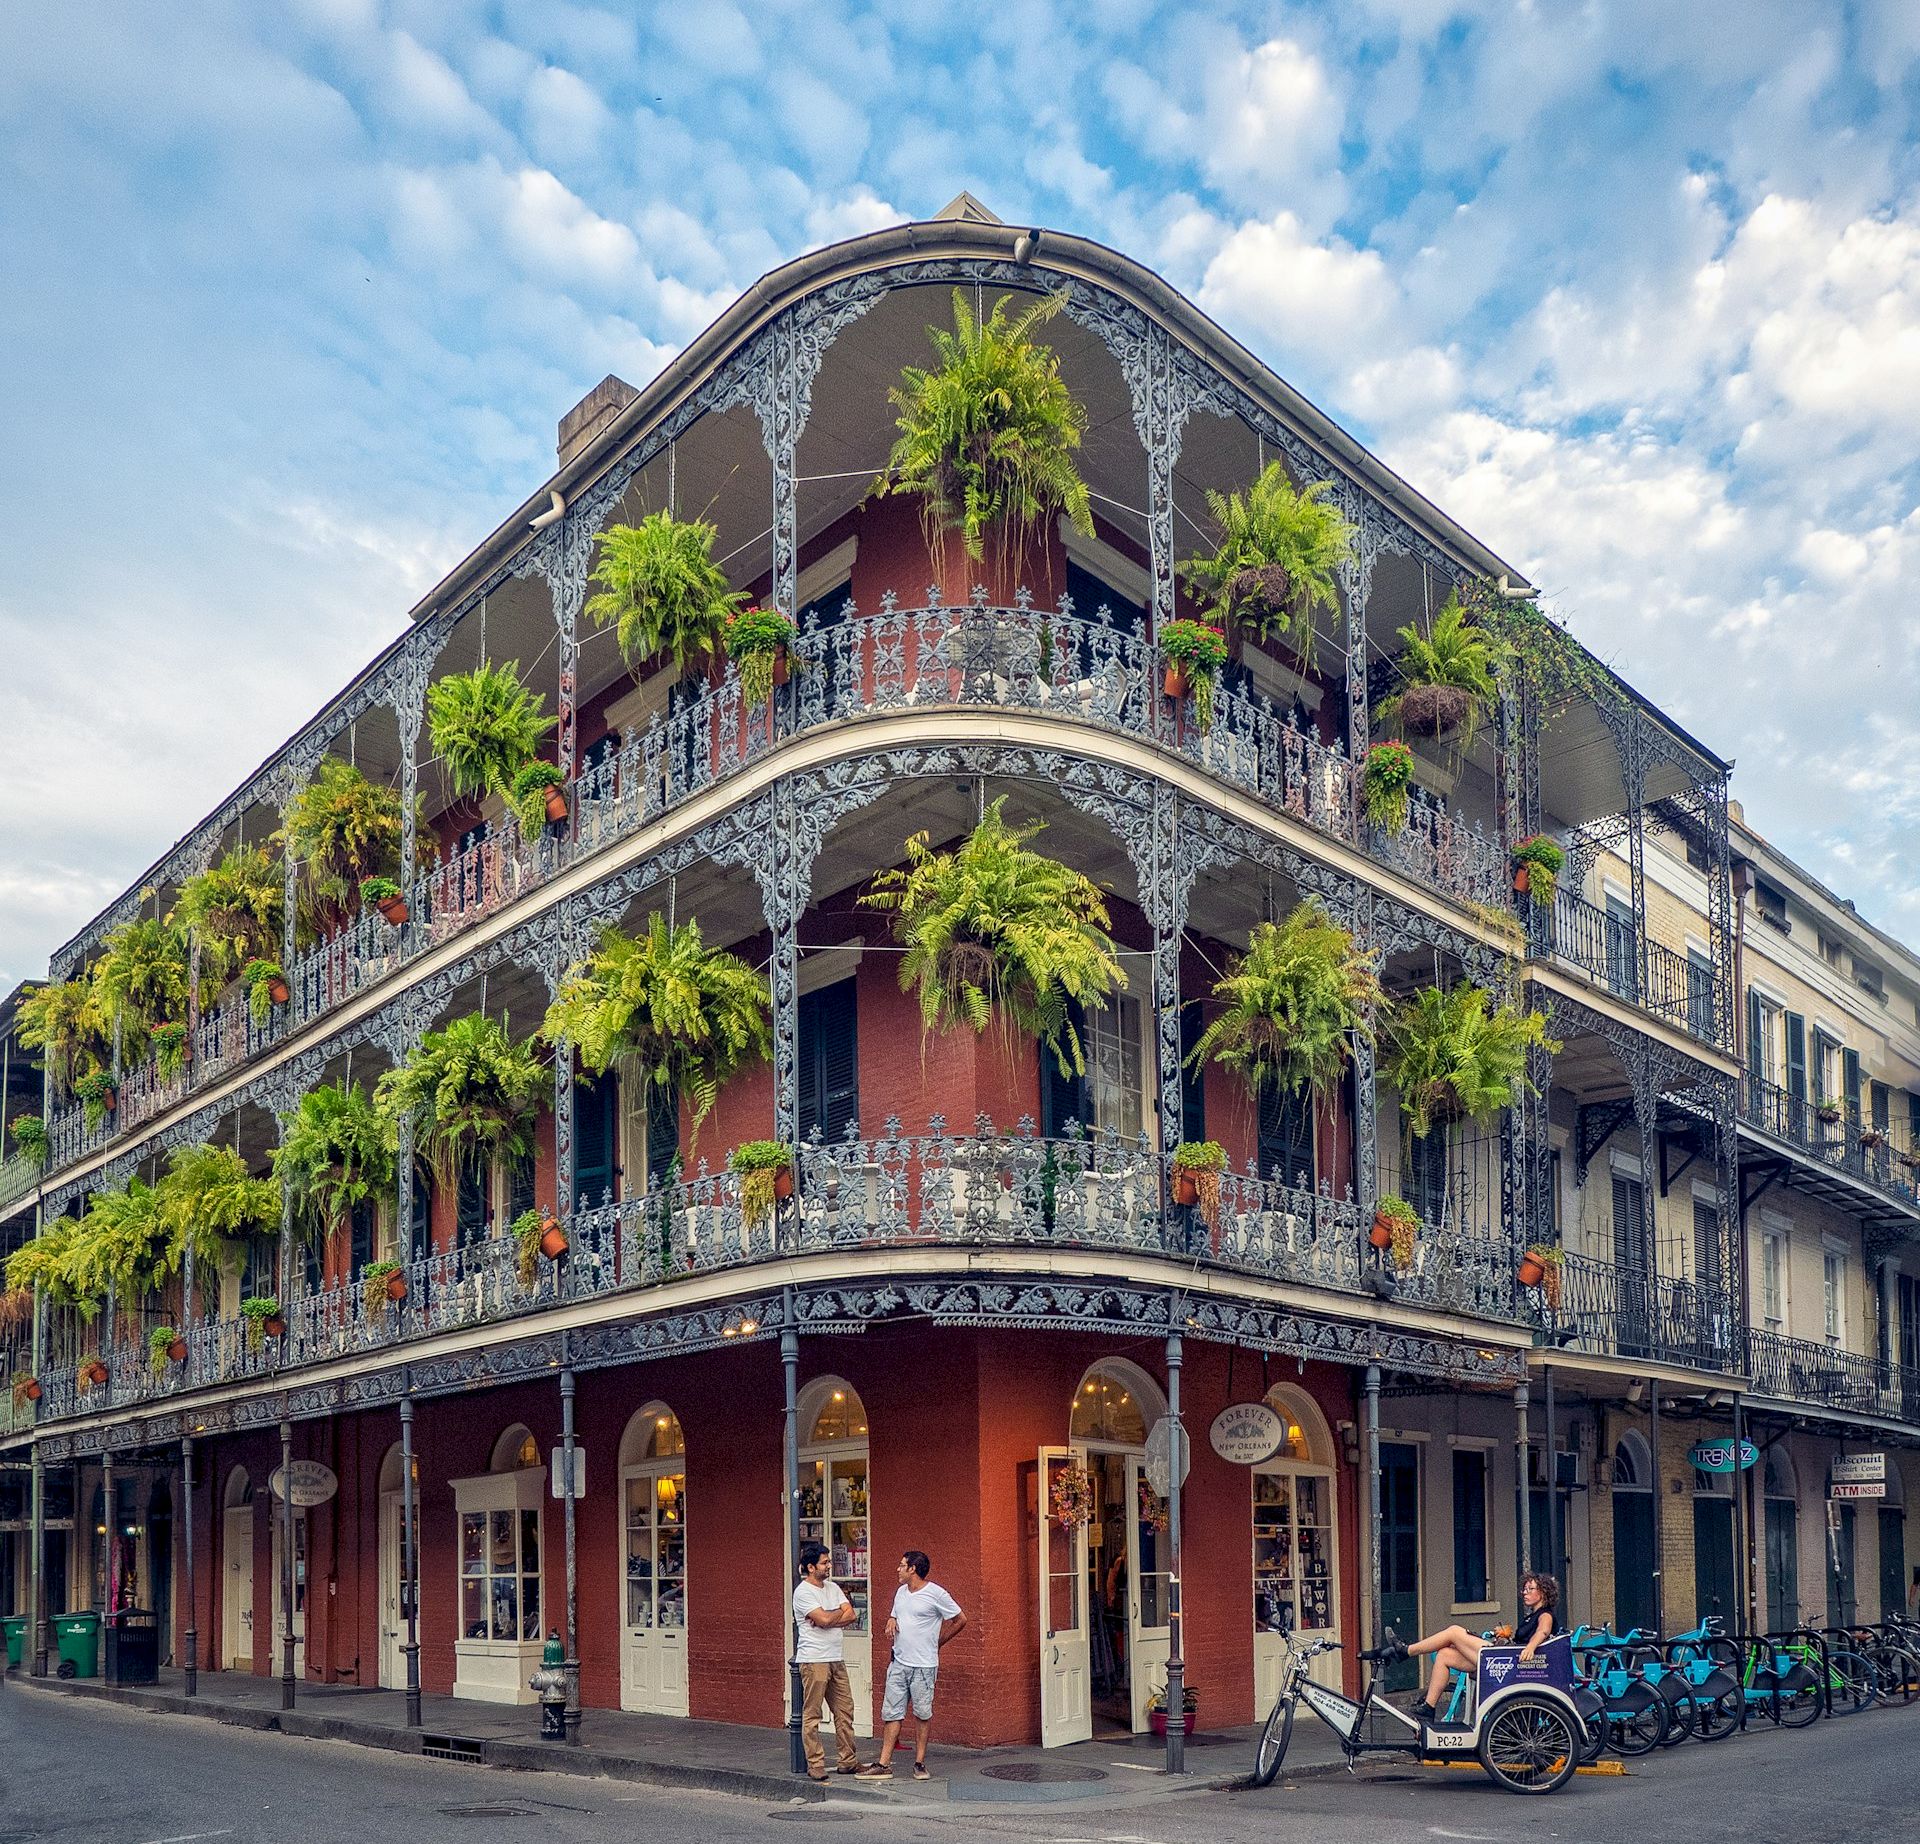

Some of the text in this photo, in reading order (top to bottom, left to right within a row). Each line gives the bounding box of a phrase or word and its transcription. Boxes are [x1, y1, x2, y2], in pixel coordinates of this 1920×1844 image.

[1219, 1409, 1272, 1429] FOREVER
[1237, 1442, 1271, 1450] ORLEANS
[1834, 1455, 1882, 1465] Discount
[1833, 1486, 1883, 1496] ATM INSIDE
[1486, 1657, 1514, 1672] Vintage
[1437, 1736, 1463, 1747] PC-22
